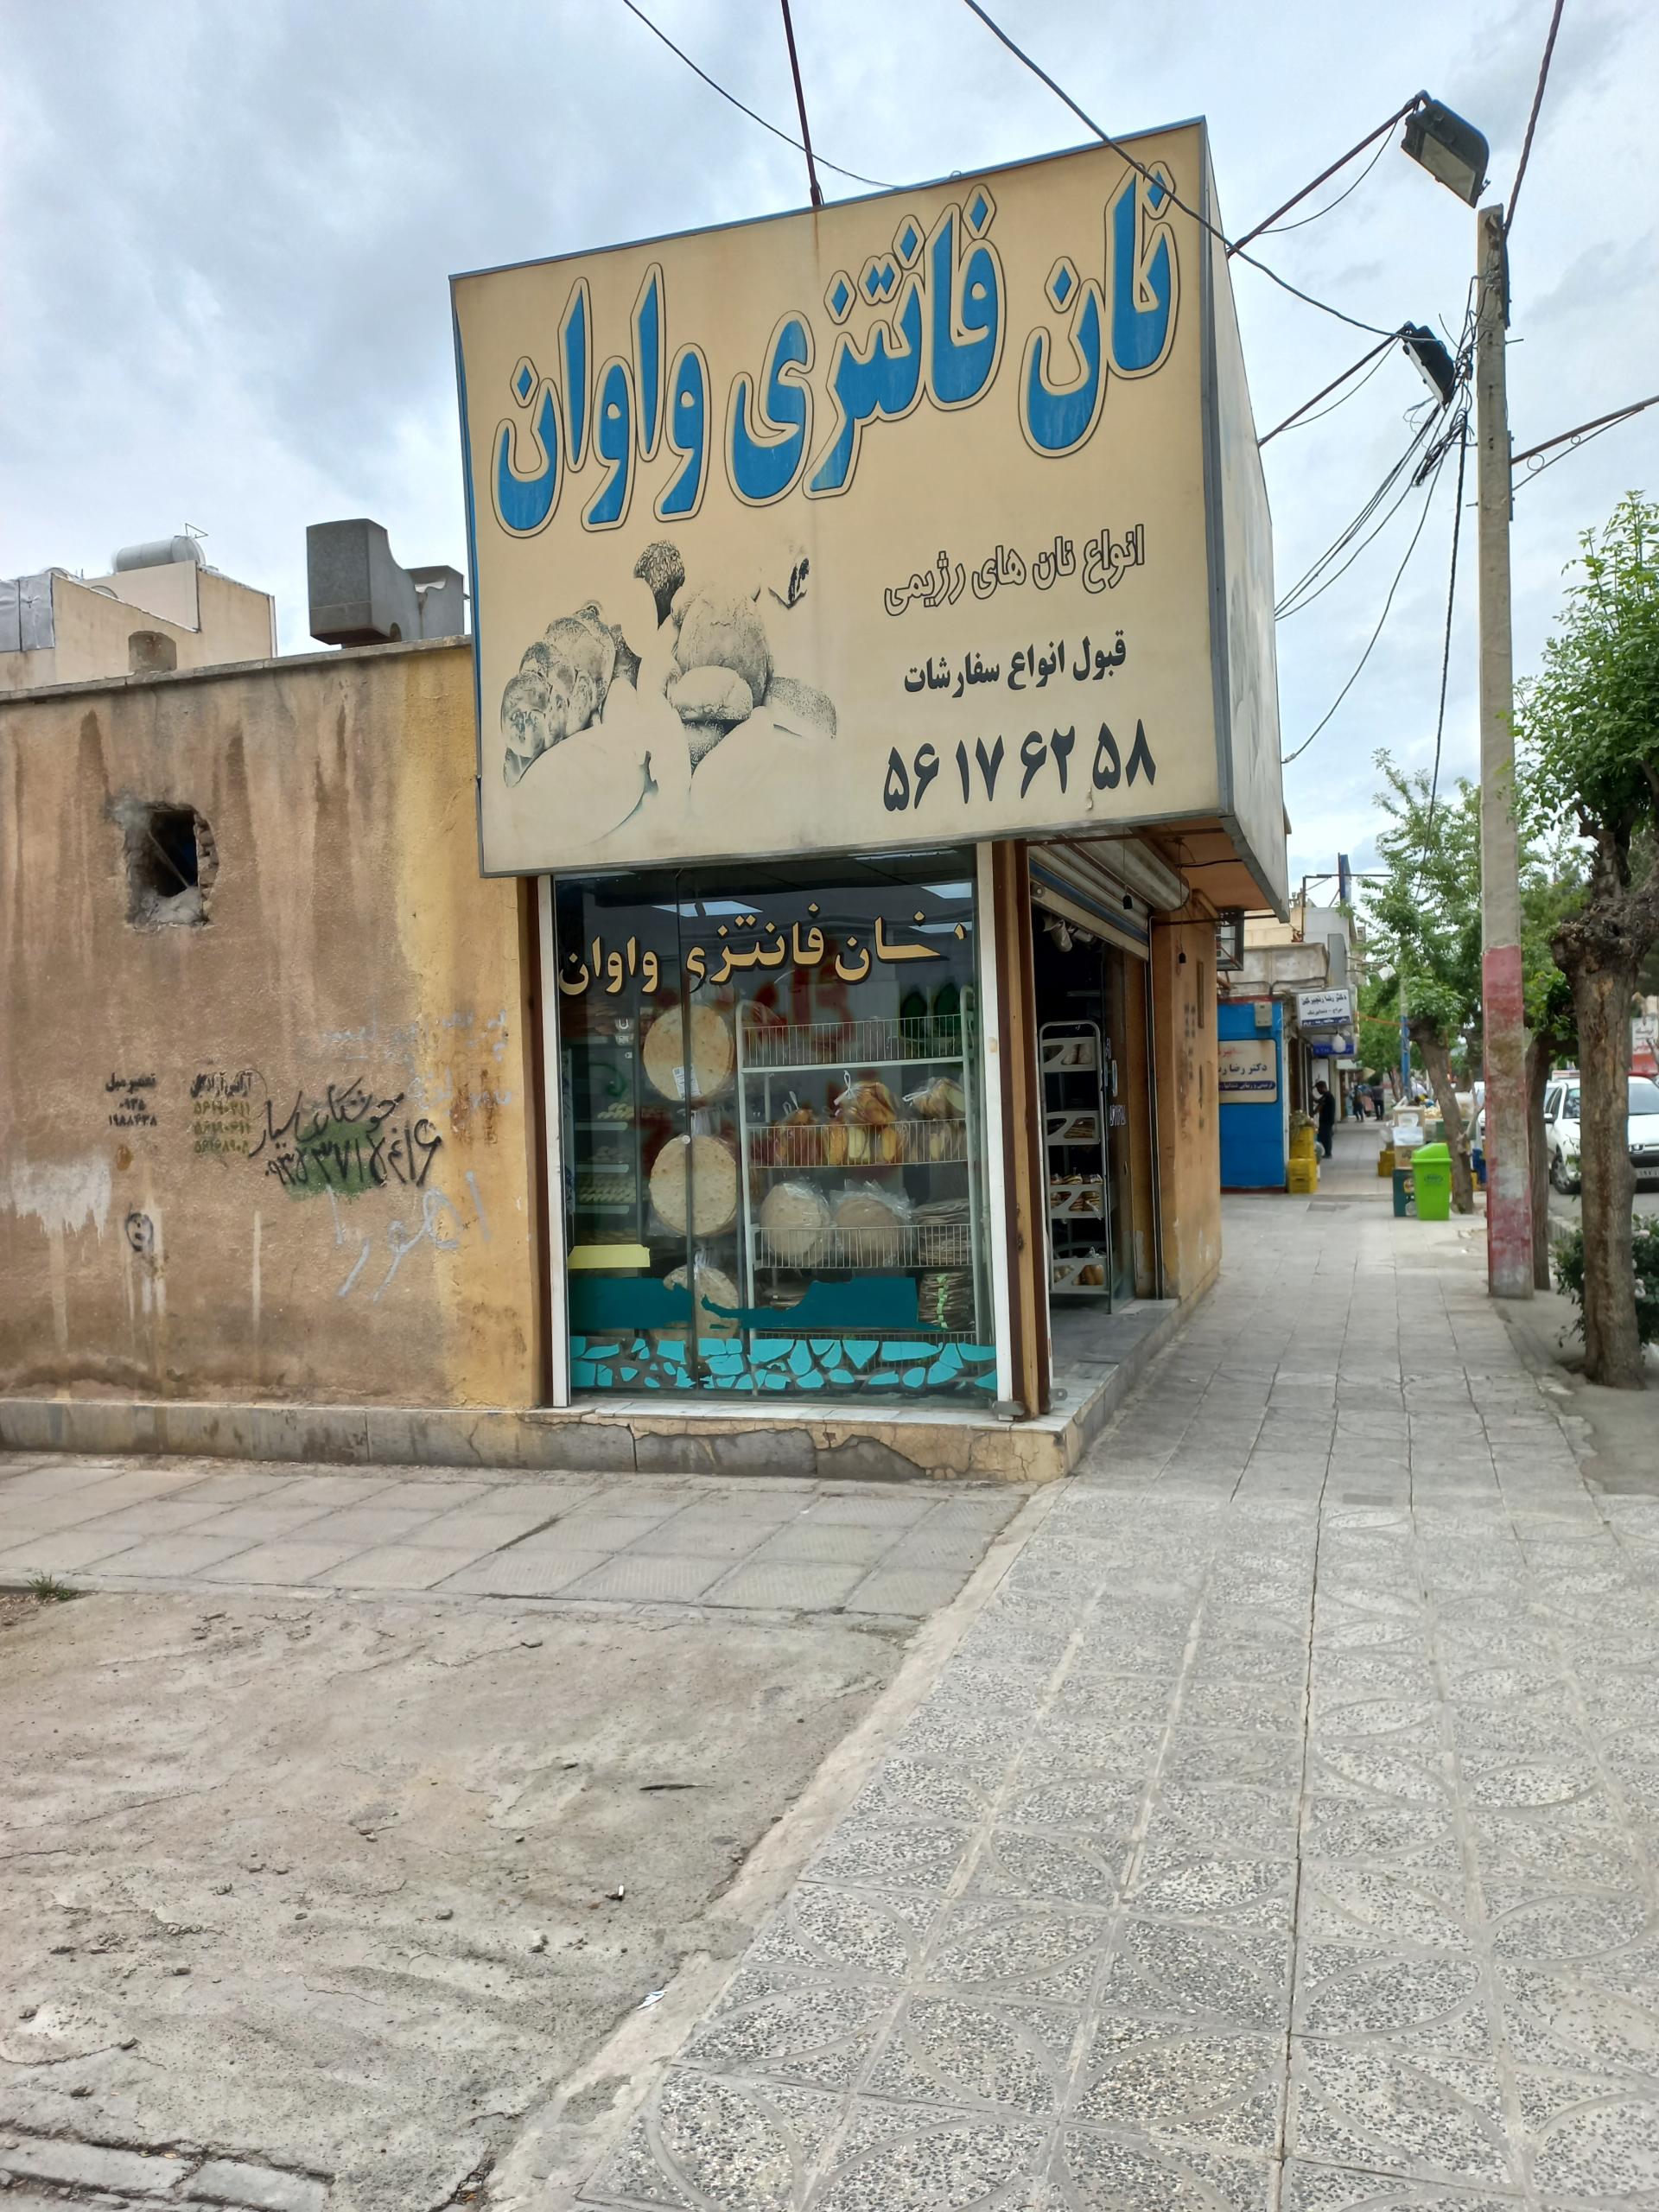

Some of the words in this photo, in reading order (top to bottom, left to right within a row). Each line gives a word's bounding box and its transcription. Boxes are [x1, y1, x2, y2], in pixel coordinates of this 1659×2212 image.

[1020, 161, 1179, 457] نان
[724, 183, 1006, 507] فانتزی
[492, 262, 710, 537] واوان
[884, 550, 966, 616] رژیمی
[972, 545, 1027, 600] های
[1033, 536, 1076, 590] نان
[1083, 524, 1145, 594] انواع
[904, 651, 1000, 698] سفارشات
[1007, 639, 1065, 690] انواع
[1073, 630, 1127, 681] قبول
[558, 936, 660, 996] واوان
[686, 902, 825, 994] فانتزی
[1230, 1063, 1245, 1075] رضا
[1248, 1063, 1268, 1075] دکتر
